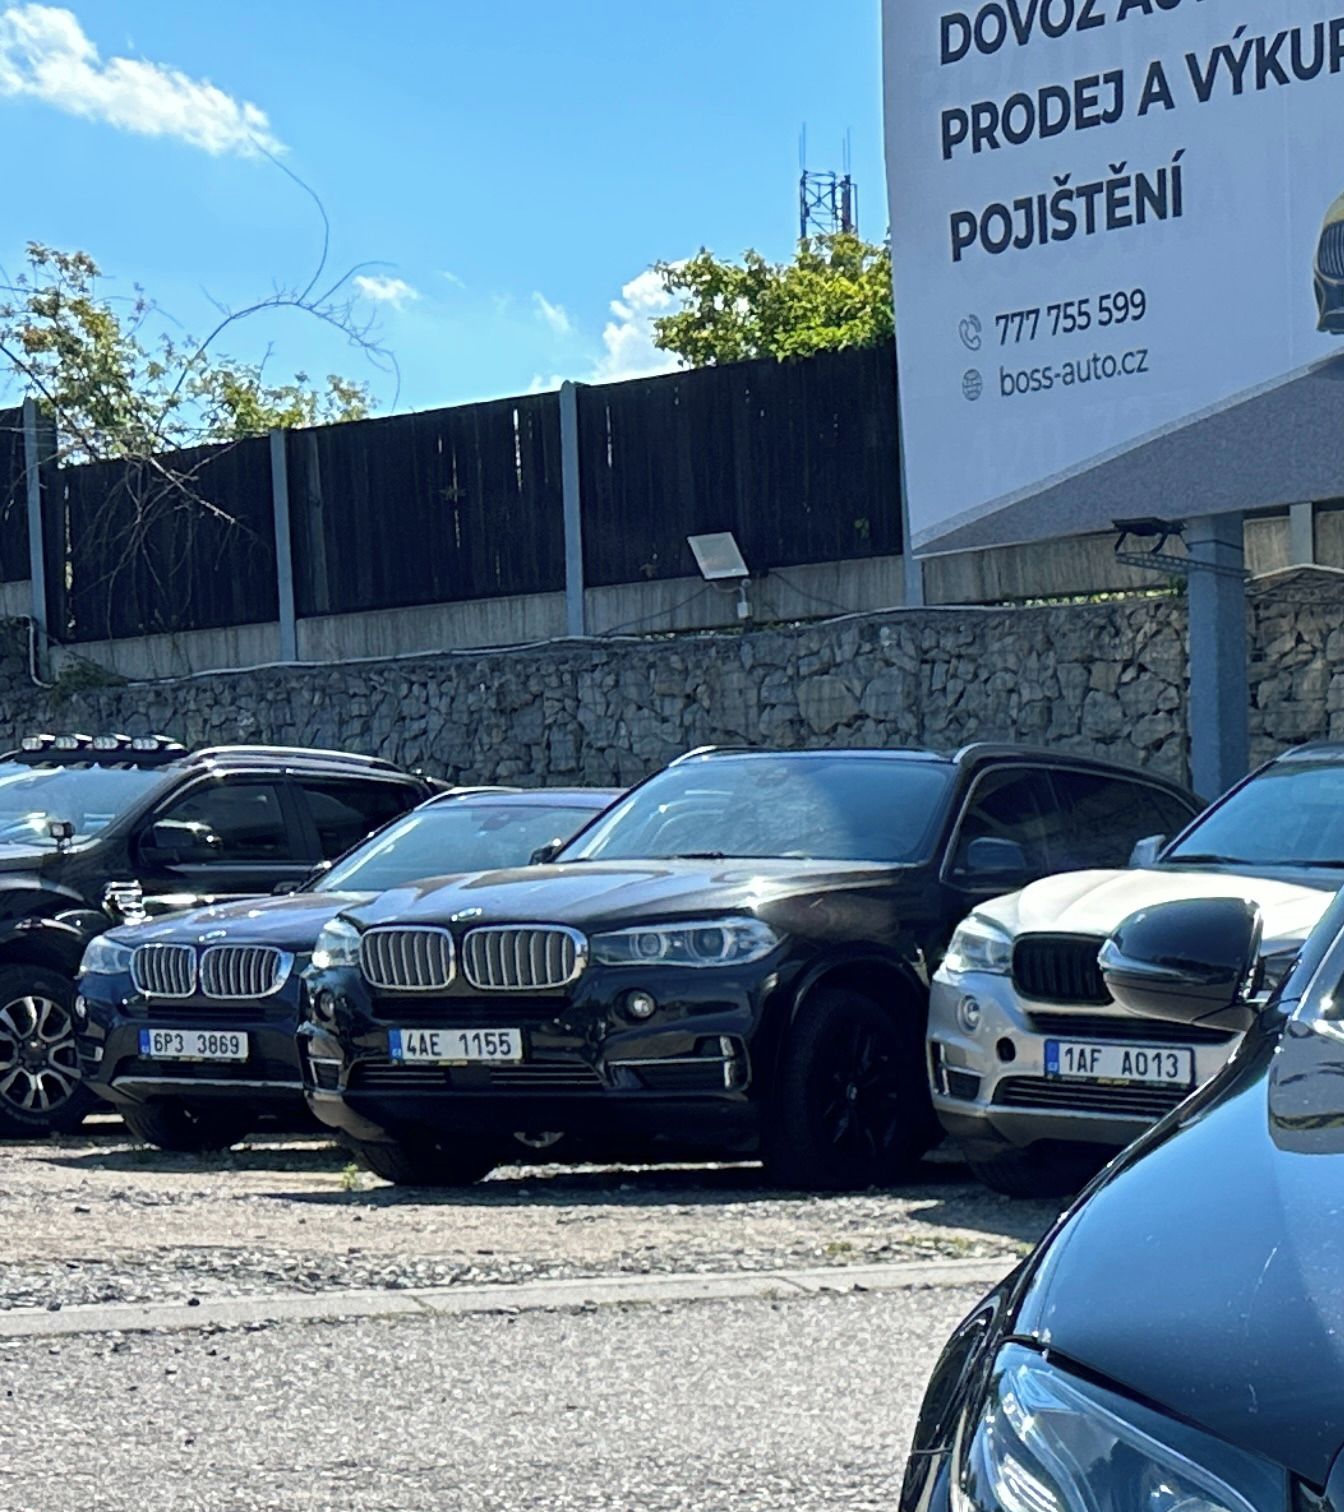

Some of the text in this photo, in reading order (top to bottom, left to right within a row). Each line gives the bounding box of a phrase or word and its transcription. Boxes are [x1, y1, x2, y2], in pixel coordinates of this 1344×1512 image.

[940, 0, 1105, 65] DOVOZ
[941, 69, 1126, 160] PRODEJ
[1137, 61, 1174, 116] A
[950, 149, 1185, 261] POJIŠTĚNÍ
[995, 288, 1146, 344] 777 755 599
[1000, 347, 1149, 397] boss-auto.cz
[154, 1033, 240, 1054] 6P3 3869
[407, 1032, 511, 1056] 4AE 1155
[1064, 1047, 1102, 1073] 1AF
